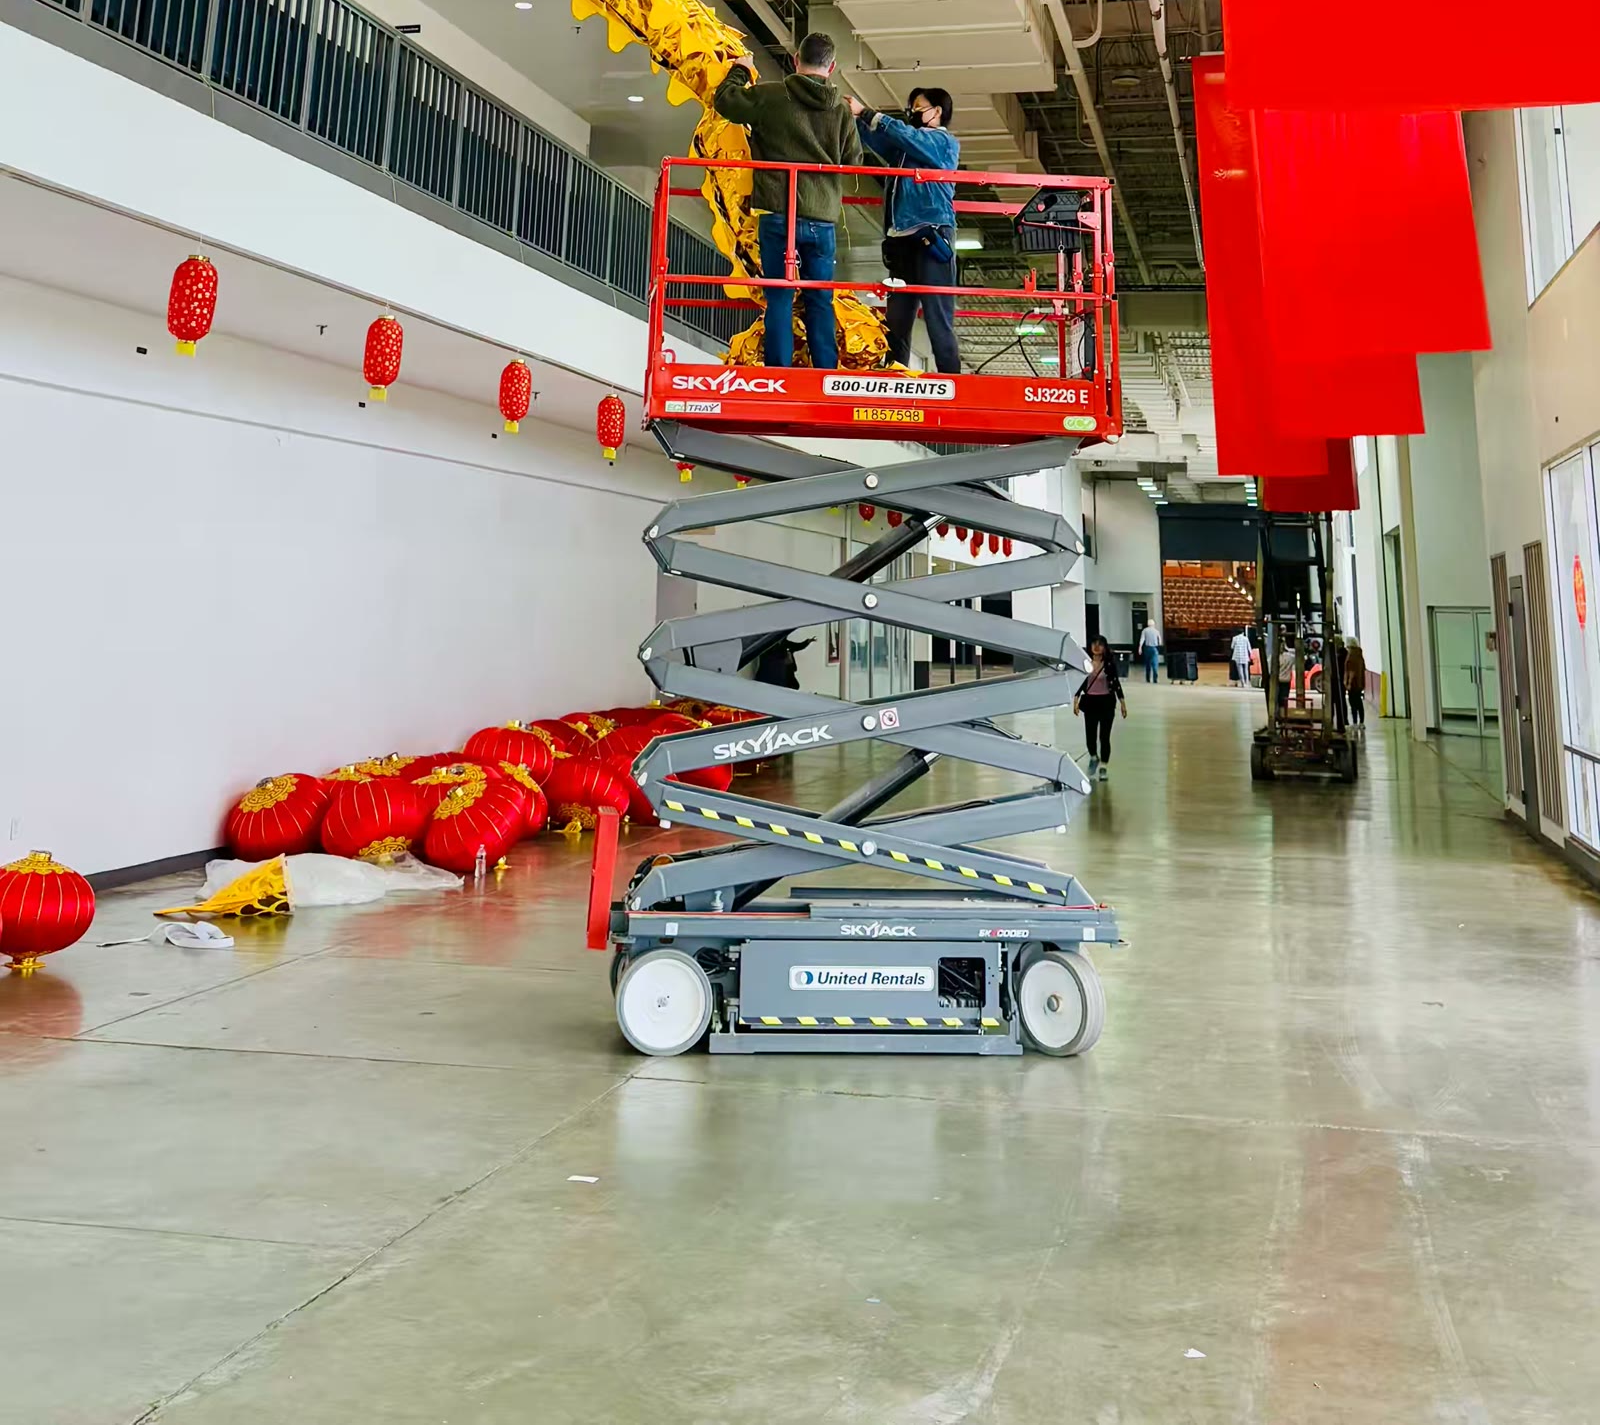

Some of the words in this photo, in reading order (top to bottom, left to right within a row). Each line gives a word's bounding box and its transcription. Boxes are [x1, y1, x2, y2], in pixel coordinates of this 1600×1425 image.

[672, 369, 787, 395] SKYJACK
[831, 380, 947, 395] 800-UR-RENTS
[1024, 386, 1076, 404] SJ3226
[1079, 389, 1089, 404] E
[855, 409, 920, 422] 11857598
[712, 725, 833, 760] SKYJACK
[840, 920, 917, 938] SKYJACK
[817, 971, 868, 985] United
[871, 972, 925, 985] Rentals
